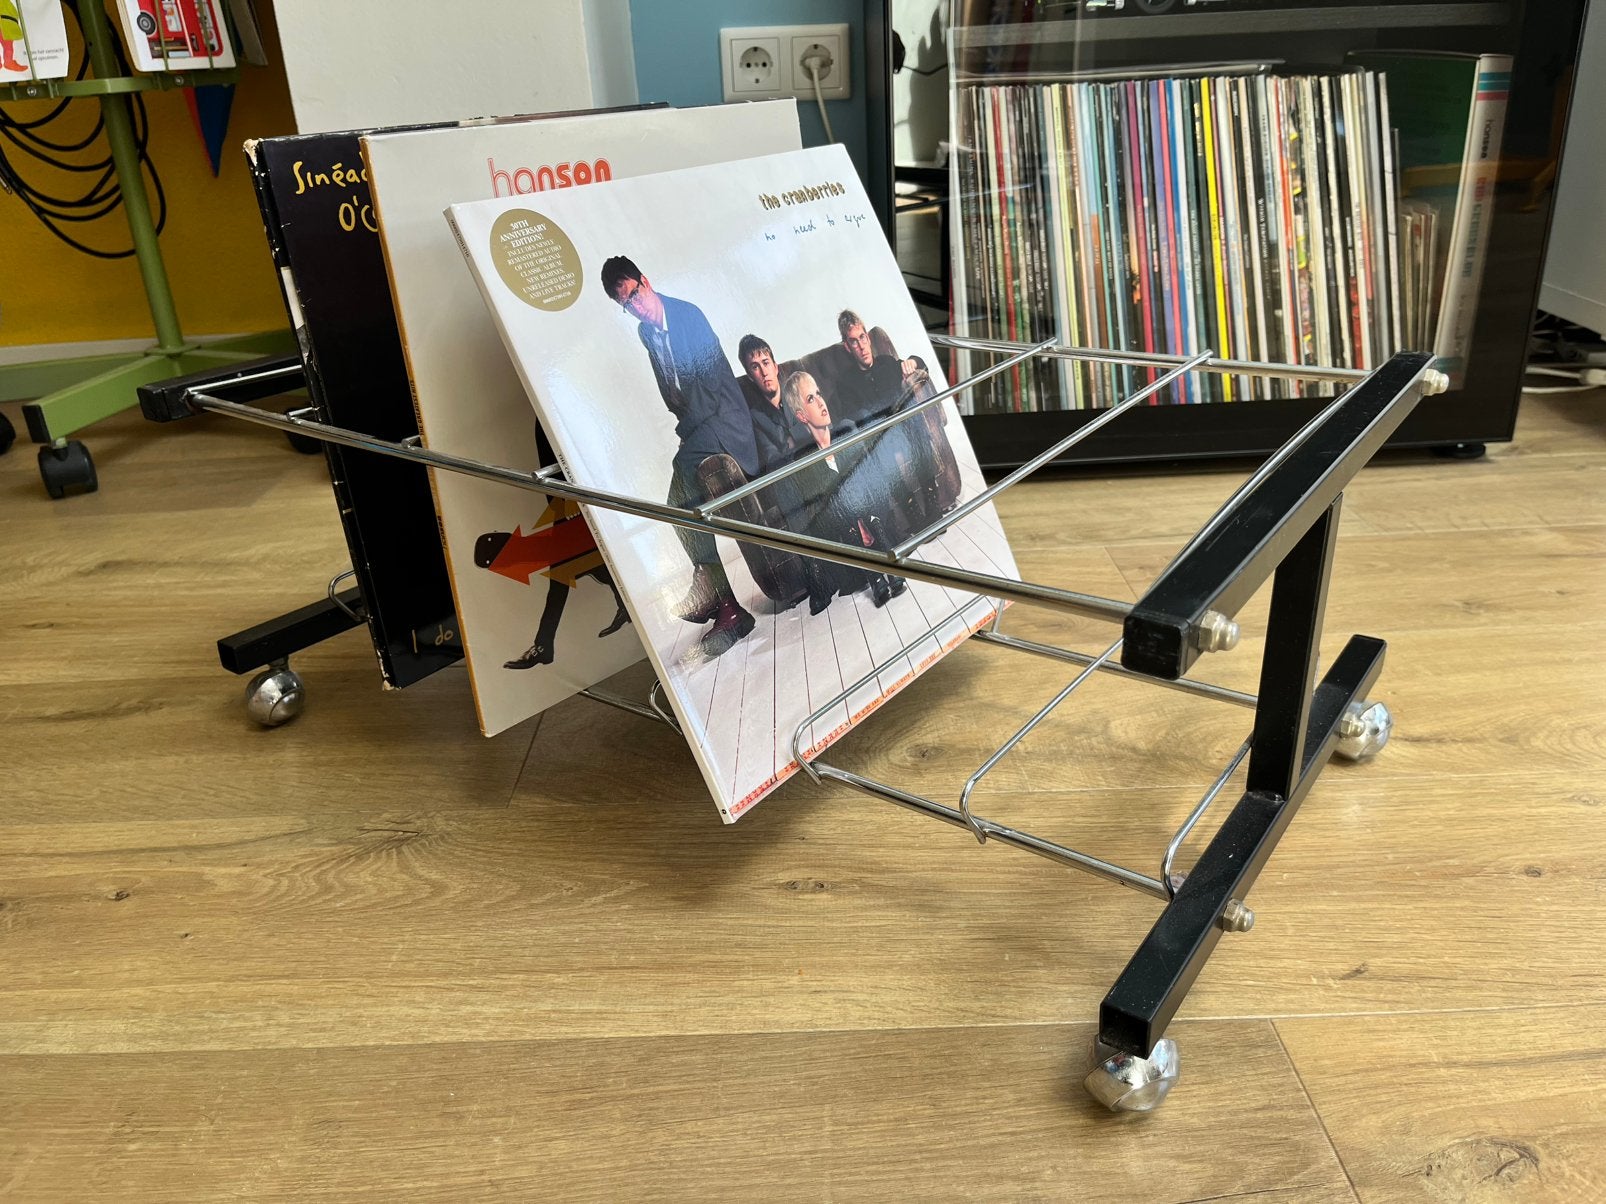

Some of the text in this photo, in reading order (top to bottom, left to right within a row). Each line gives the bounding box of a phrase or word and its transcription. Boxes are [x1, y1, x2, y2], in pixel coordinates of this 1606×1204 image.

[487, 157, 612, 198] hanson
[759, 181, 846, 211] the cranberries
[339, 195, 378, 232] O'C
[500, 223, 547, 242] ANNIVERSARY
[511, 233, 544, 248] EDITION!
[435, 624, 454, 646] do
